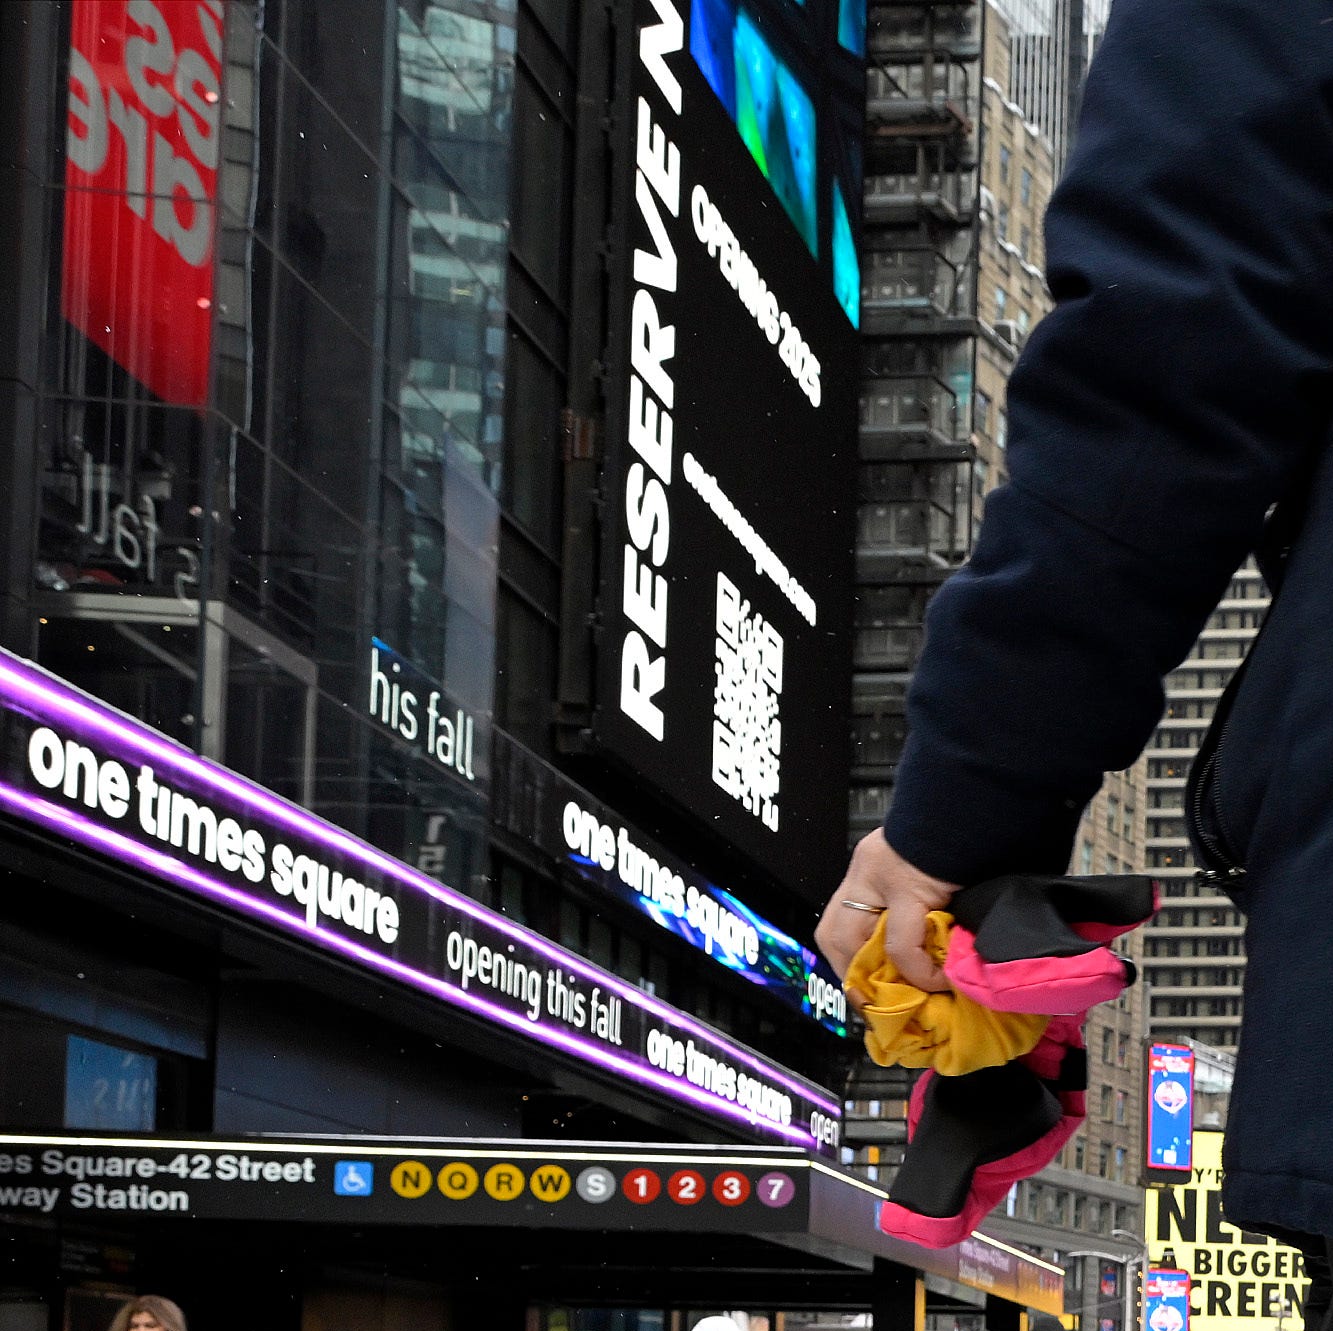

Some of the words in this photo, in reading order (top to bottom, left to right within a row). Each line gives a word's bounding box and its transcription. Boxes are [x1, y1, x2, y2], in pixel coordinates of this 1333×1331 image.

[620, 97, 683, 741] RESERVE
[369, 648, 418, 740] his
[427, 691, 474, 781] fall
[29, 727, 130, 818] one
[136, 765, 266, 882] times
[271, 844, 399, 943] square
[563, 801, 616, 871] one
[617, 827, 686, 918] times
[686, 886, 760, 965] square
[446, 931, 542, 1021] opening
[546, 968, 586, 1028] this
[590, 987, 622, 1046] fall
[646, 1028, 687, 1077] one
[686, 1040, 737, 1100] times
[736, 1073, 793, 1125] square
[41, 1149, 212, 1180] Square-42
[215, 1156, 315, 1183] Street
[70, 1182, 189, 1211] Station
[1190, 1279, 1311, 1319] CREEN
[1194, 1248, 1307, 1278] BIGGER
